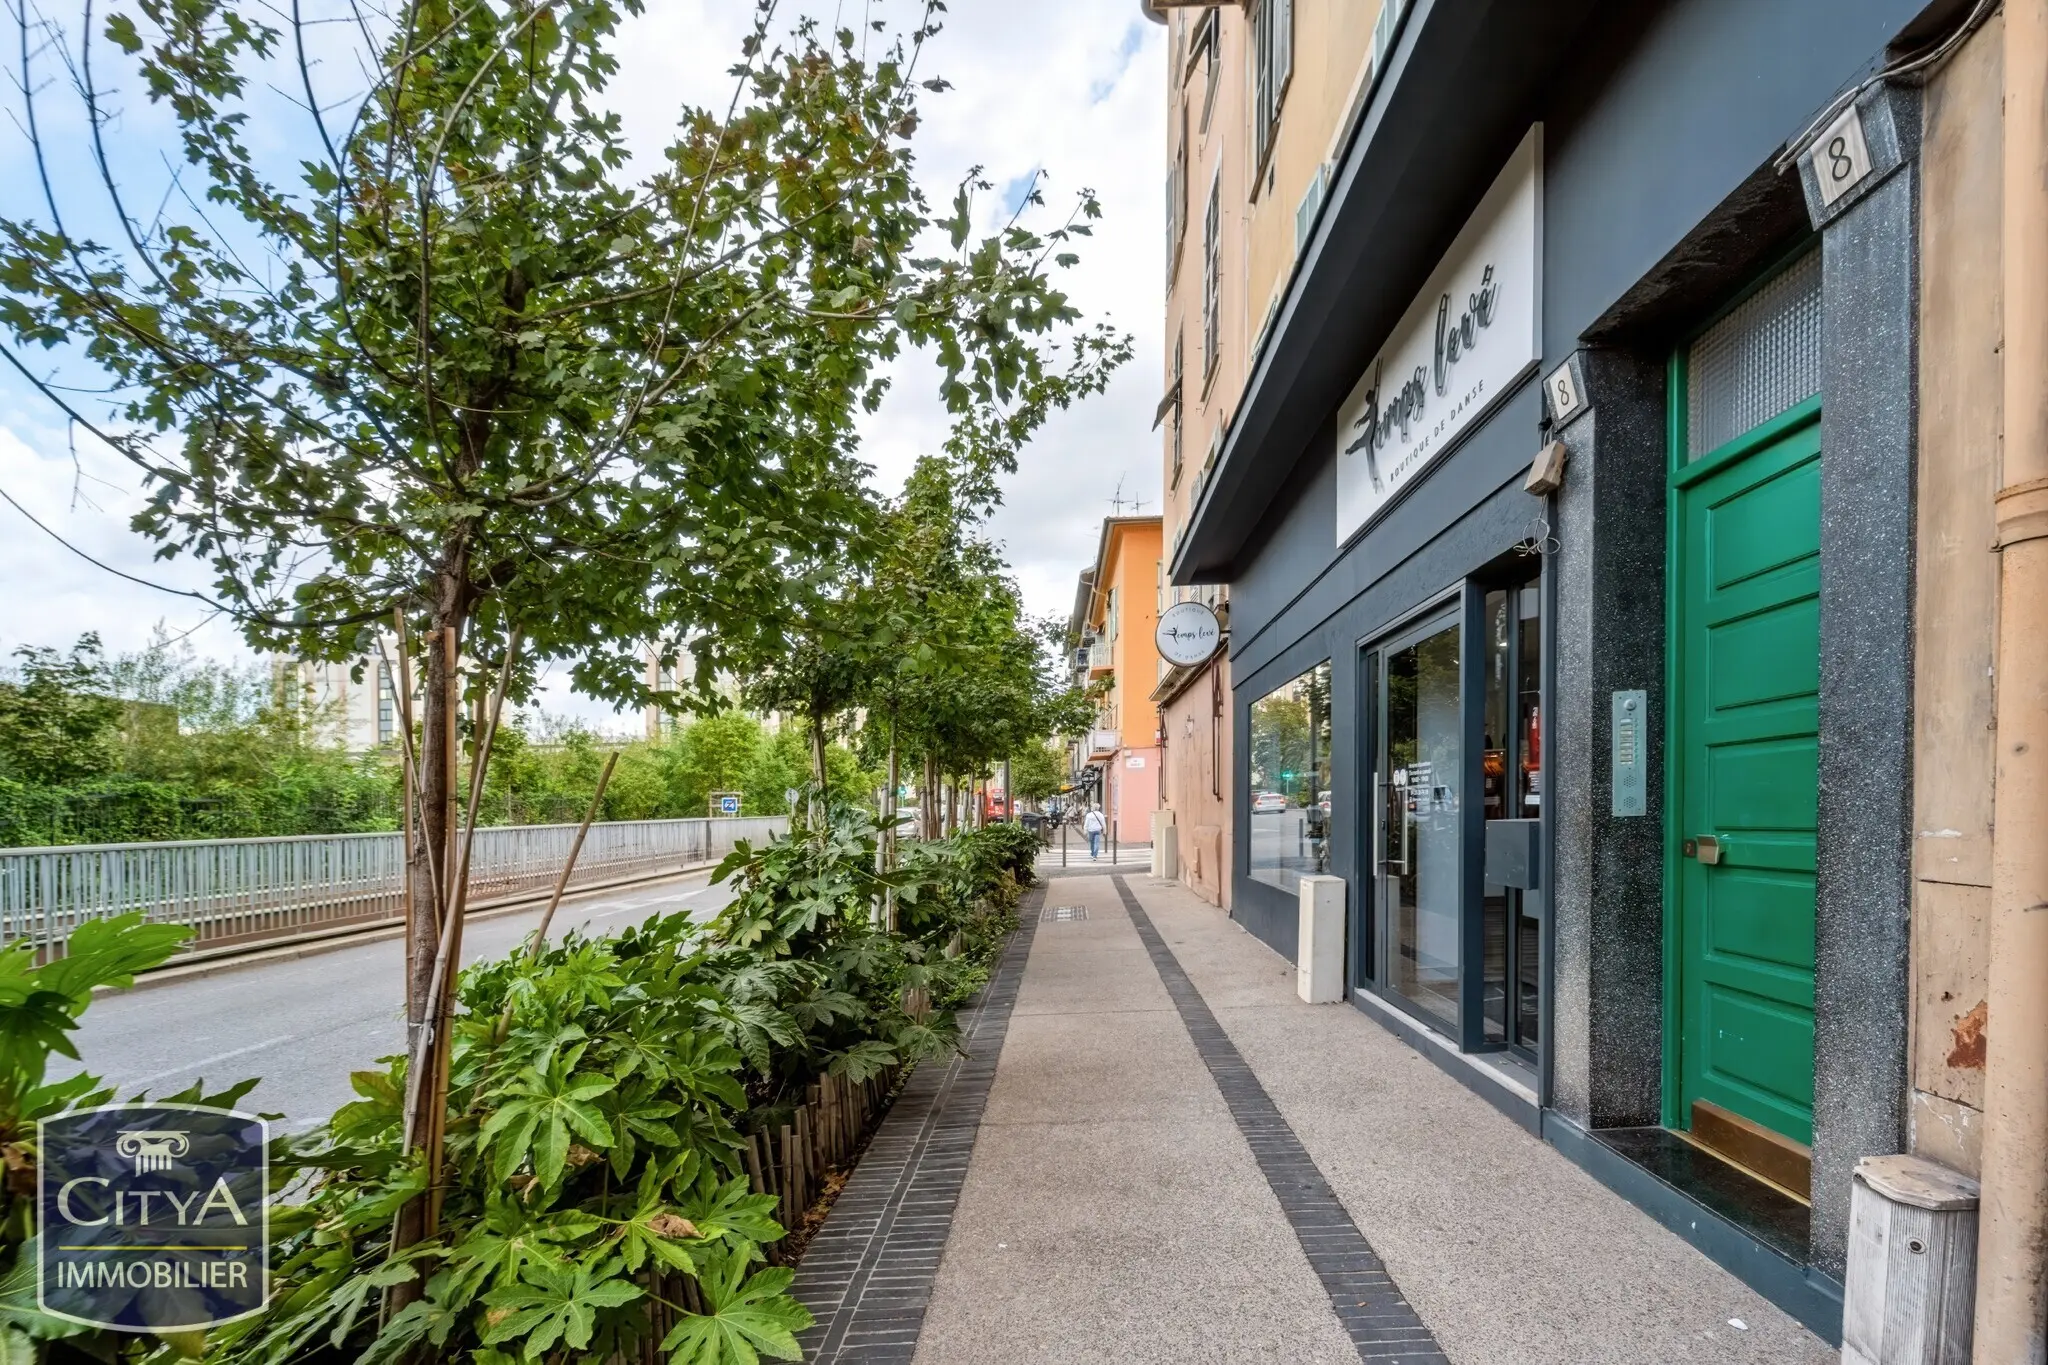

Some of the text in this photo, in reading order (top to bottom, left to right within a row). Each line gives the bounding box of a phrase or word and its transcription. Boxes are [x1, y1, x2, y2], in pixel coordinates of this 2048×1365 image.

[1828, 136, 1852, 183] 8
[1557, 379, 1570, 406] 8
[1390, 379, 1484, 482] BOUTIQUE DE DANSE
[1172, 606, 1205, 618] BOUTIQUE
